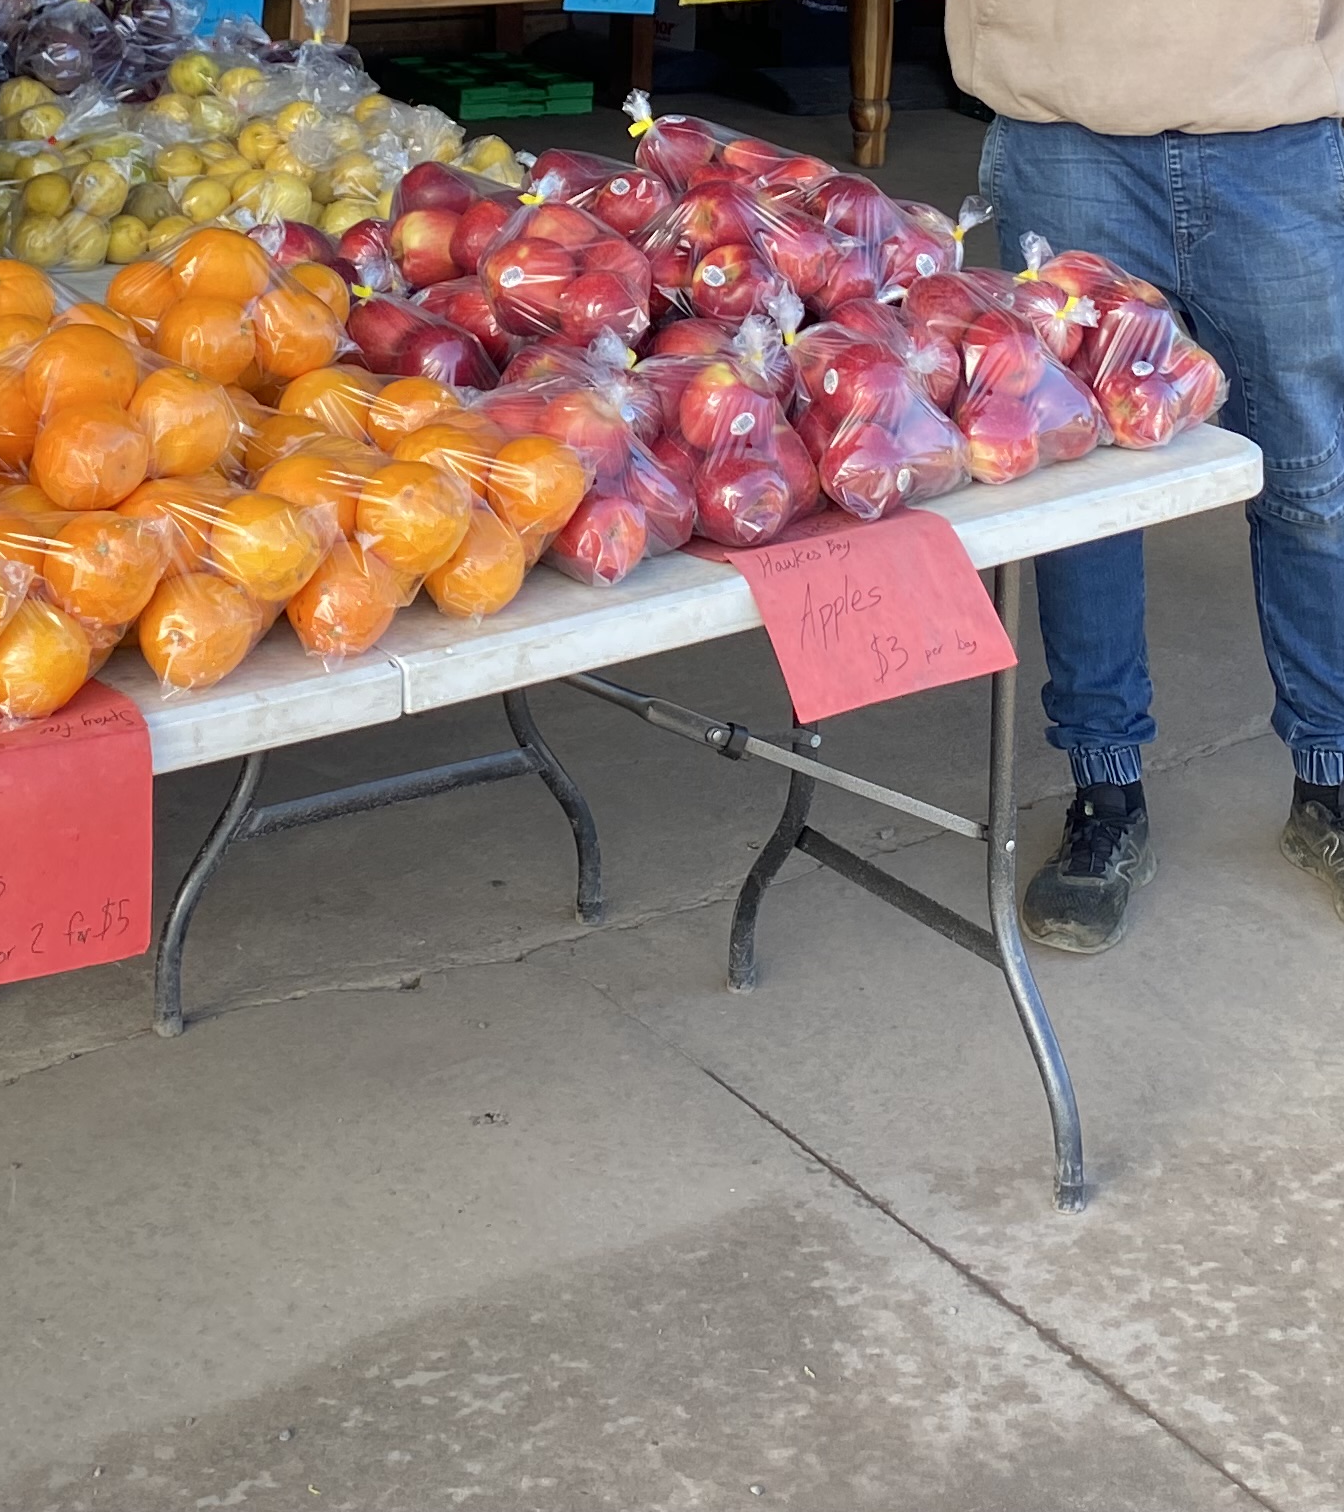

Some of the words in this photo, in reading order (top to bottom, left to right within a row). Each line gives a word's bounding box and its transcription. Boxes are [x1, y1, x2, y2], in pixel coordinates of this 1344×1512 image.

[757, 547, 822, 579] Hawkes
[826, 539, 852, 562] Bay
[799, 574, 883, 651] Apples
[869, 633, 909, 684] $3
[924, 643, 944, 663] per
[953, 629, 978, 655] bag
[81, 707, 135, 727] Spray
[31, 922, 45, 955] 2
[63, 910, 92, 944] for
[91, 897, 130, 939] $5
